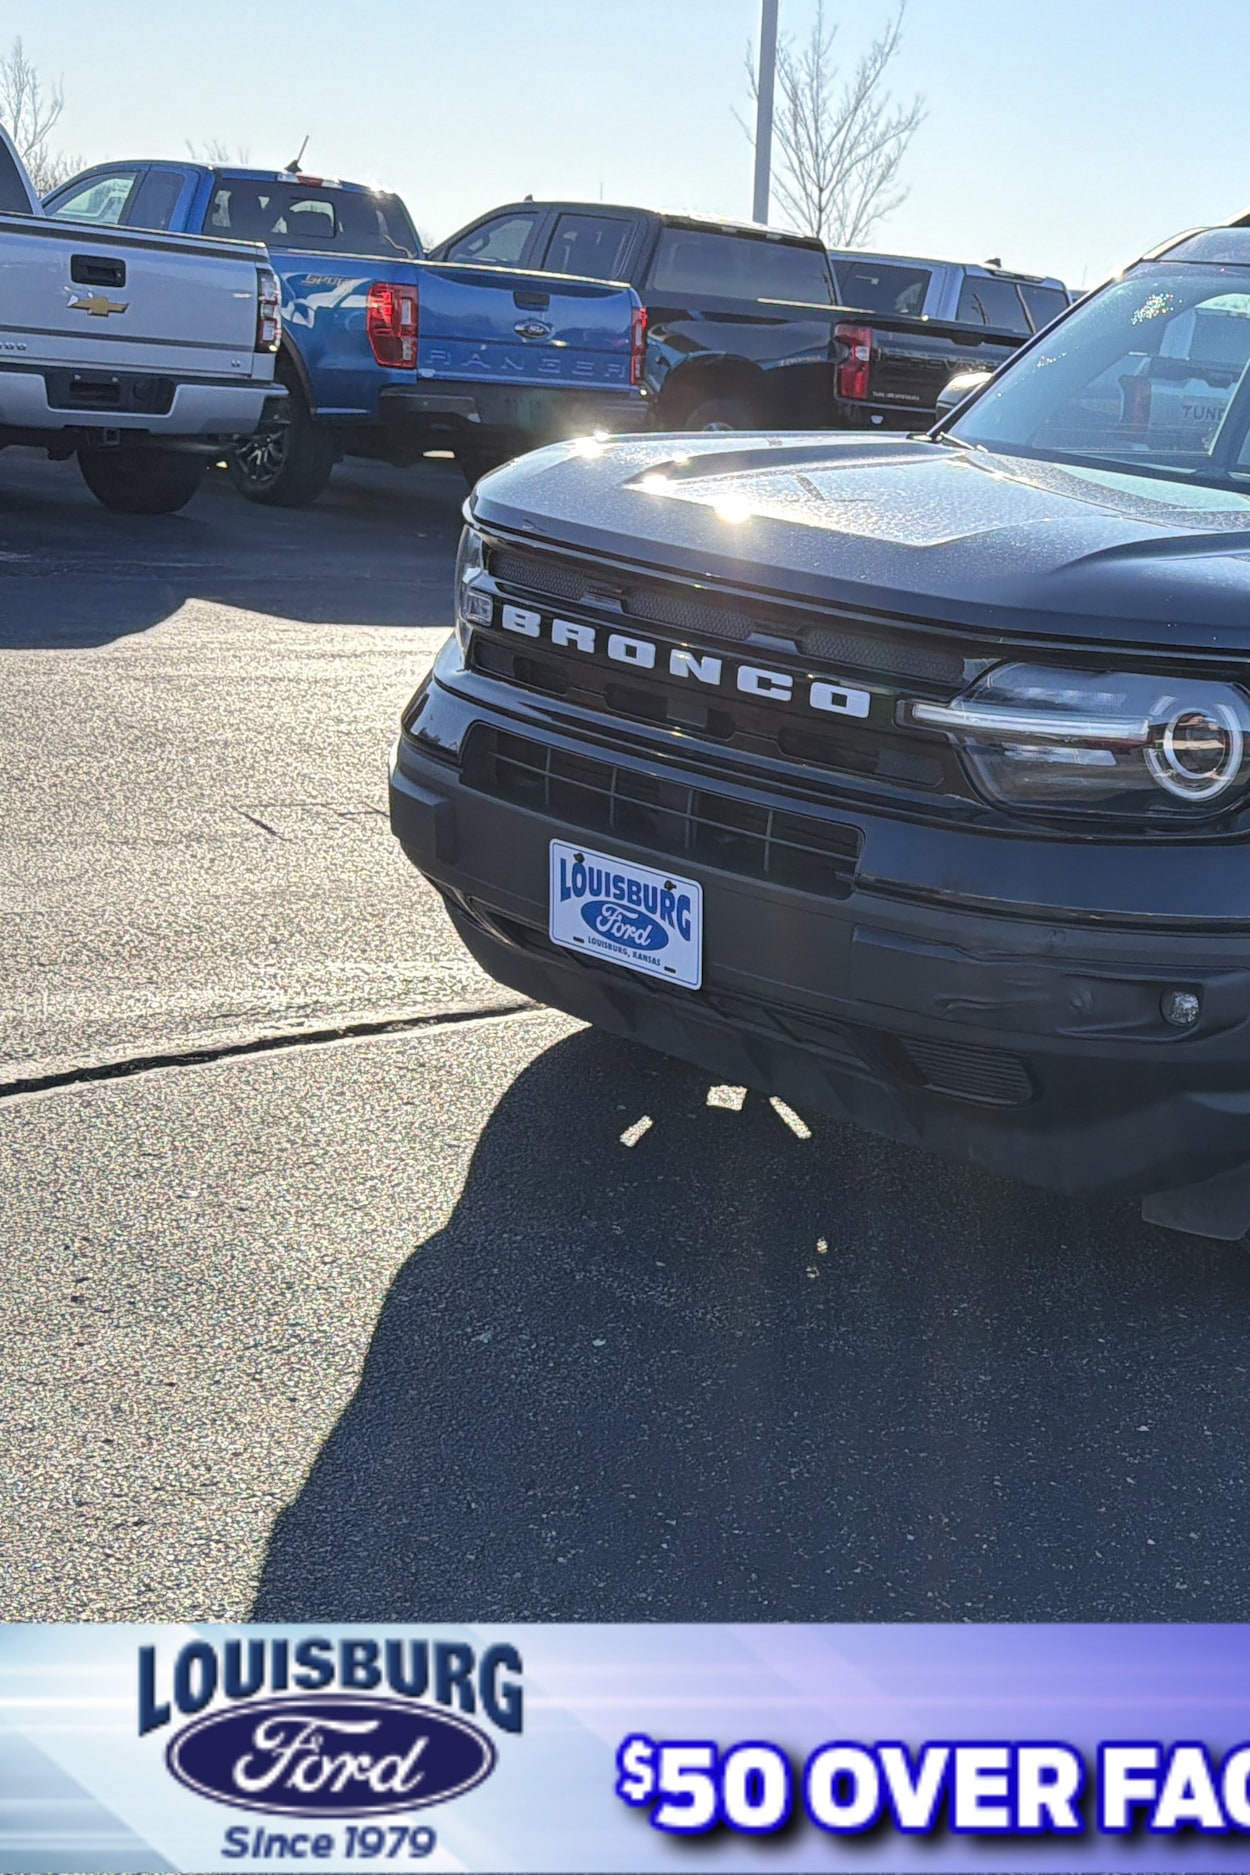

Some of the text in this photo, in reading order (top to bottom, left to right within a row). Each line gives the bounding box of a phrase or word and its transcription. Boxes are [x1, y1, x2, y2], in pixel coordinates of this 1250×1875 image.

[424, 349, 625, 378] RANGER
[502, 604, 871, 719] BRONCO
[560, 857, 691, 942] LOUISBURG
[596, 904, 652, 946] Ford
[587, 936, 661, 967] LOUISBURG, KANSAS
